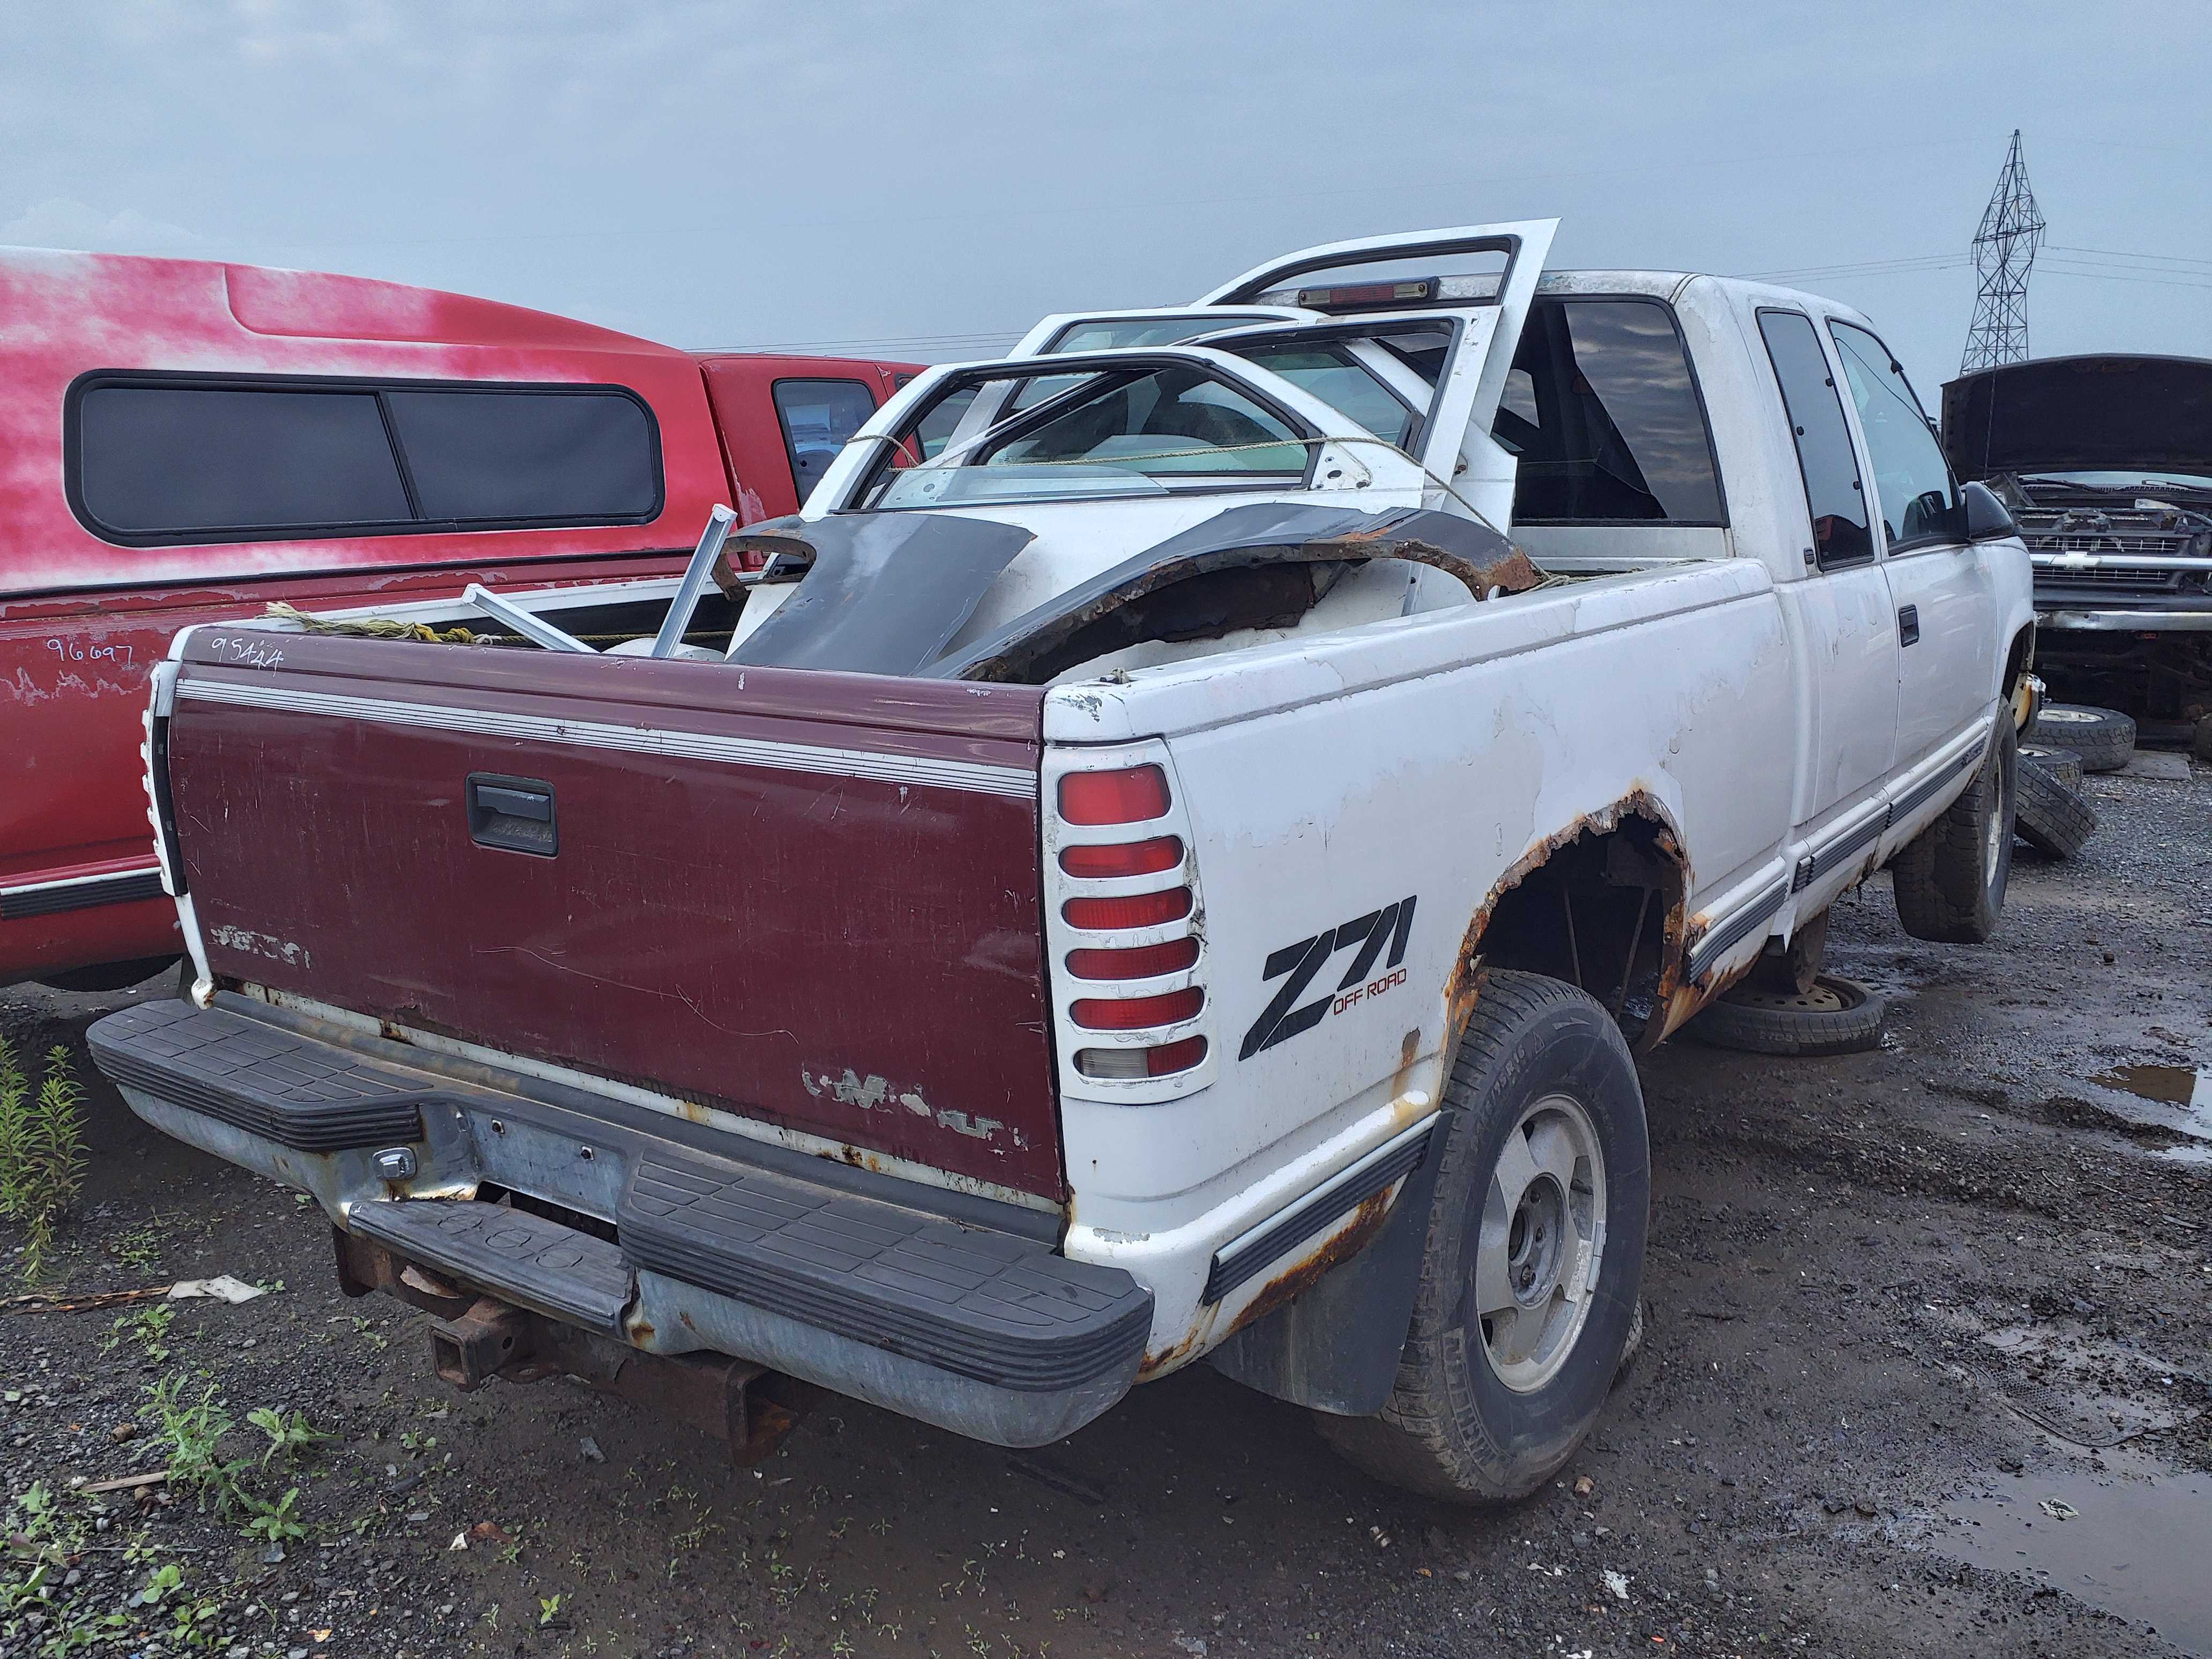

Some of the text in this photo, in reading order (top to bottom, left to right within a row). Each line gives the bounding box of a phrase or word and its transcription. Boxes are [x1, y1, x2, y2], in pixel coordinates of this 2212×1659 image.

[47, 639, 132, 668] 96697
[211, 637, 285, 677] 95444
[1238, 895, 1417, 1062] Z71
[1333, 968, 1407, 1015] OFF ROAD
